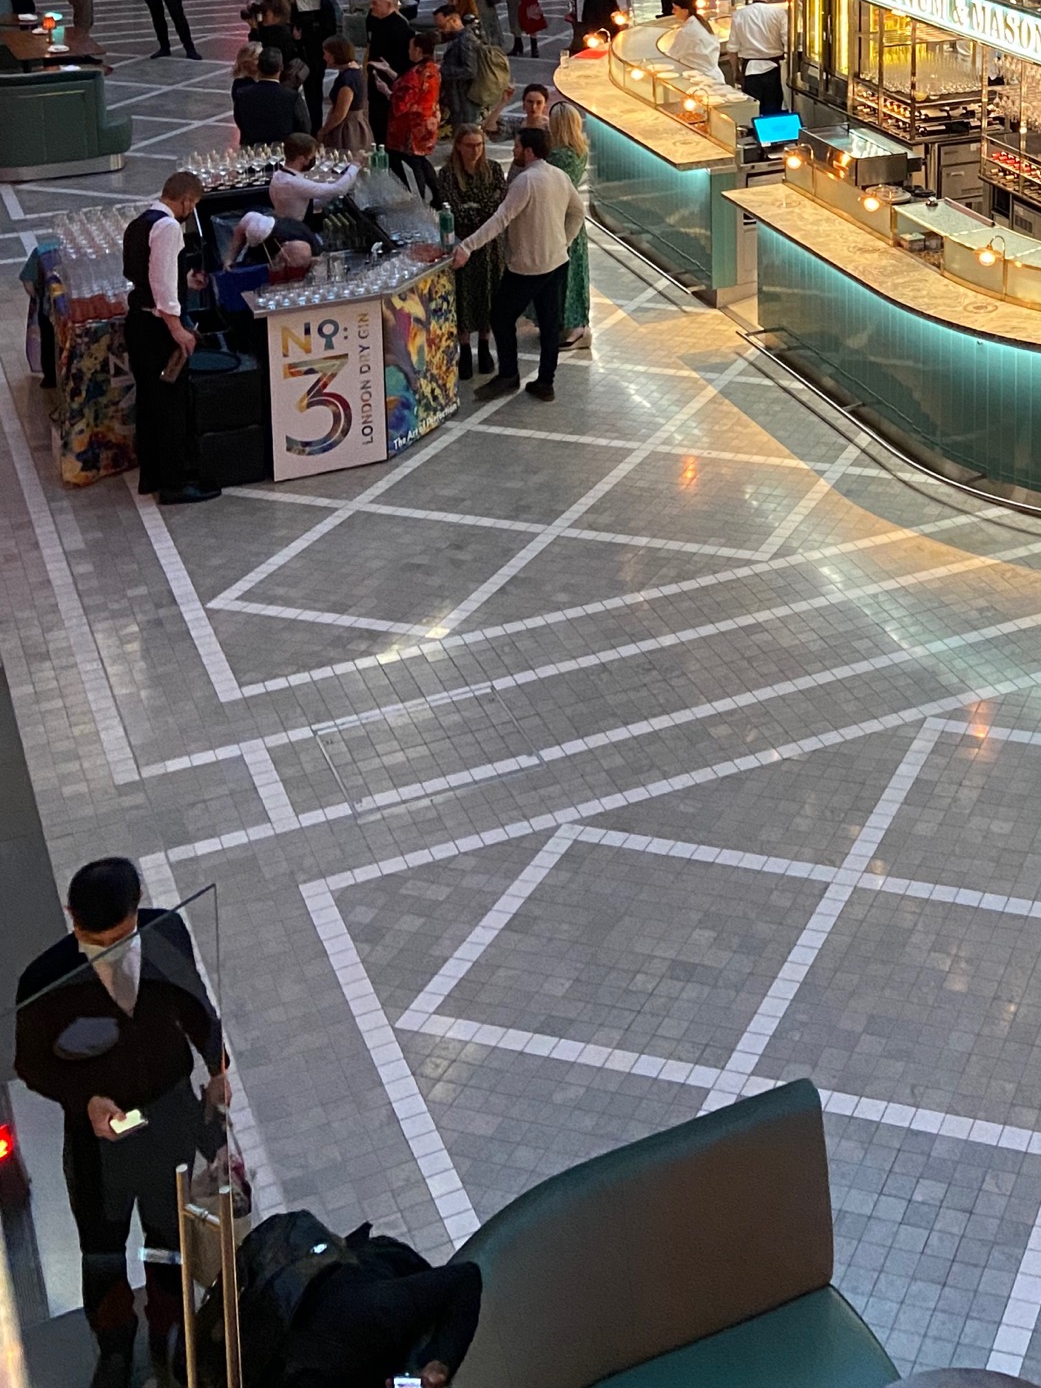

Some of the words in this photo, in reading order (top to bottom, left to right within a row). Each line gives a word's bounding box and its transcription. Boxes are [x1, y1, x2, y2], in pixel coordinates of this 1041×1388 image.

[357, 312, 370, 339] GIN
[359, 344, 371, 374] DRY
[282, 353, 353, 456] 3
[360, 379, 374, 445] LONDON
[393, 436, 406, 451] The
[407, 428, 419, 442] Art
